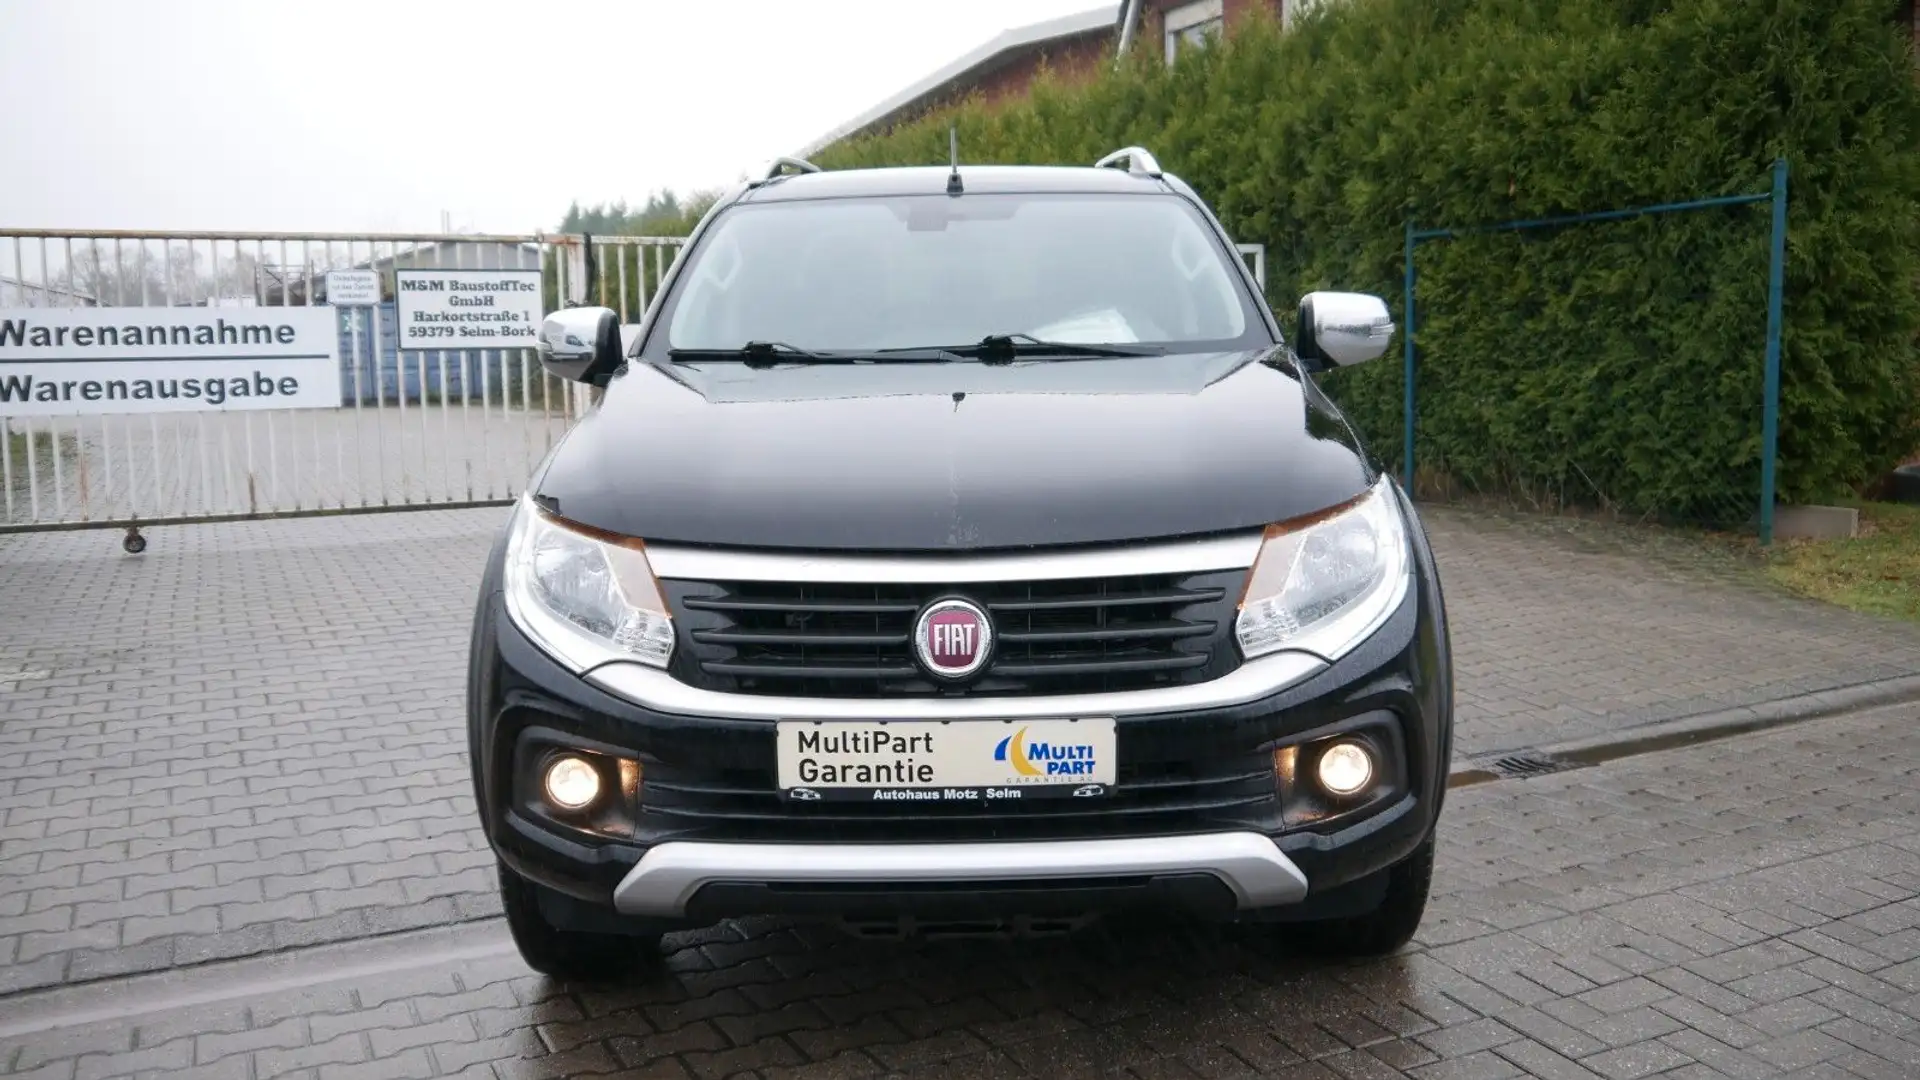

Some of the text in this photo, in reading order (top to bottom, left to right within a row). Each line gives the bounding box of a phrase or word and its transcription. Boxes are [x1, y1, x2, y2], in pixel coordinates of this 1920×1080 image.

[401, 279, 535, 292] M&M BaustoffTec
[448, 295, 494, 307] GmbH
[413, 311, 530, 322] Harkortstraße 1
[0, 319, 295, 346] Warenannahme
[409, 326, 535, 337] 59379 Selm-Bork
[0, 371, 298, 405] Warenausgabe
[933, 624, 975, 655] FIAT
[798, 731, 933, 753] MultiPart
[1028, 743, 1093, 760] MULTI
[799, 758, 933, 783] Garantie
[1047, 761, 1095, 775] PART
[873, 788, 1021, 800] Autohaus Motz Selm
